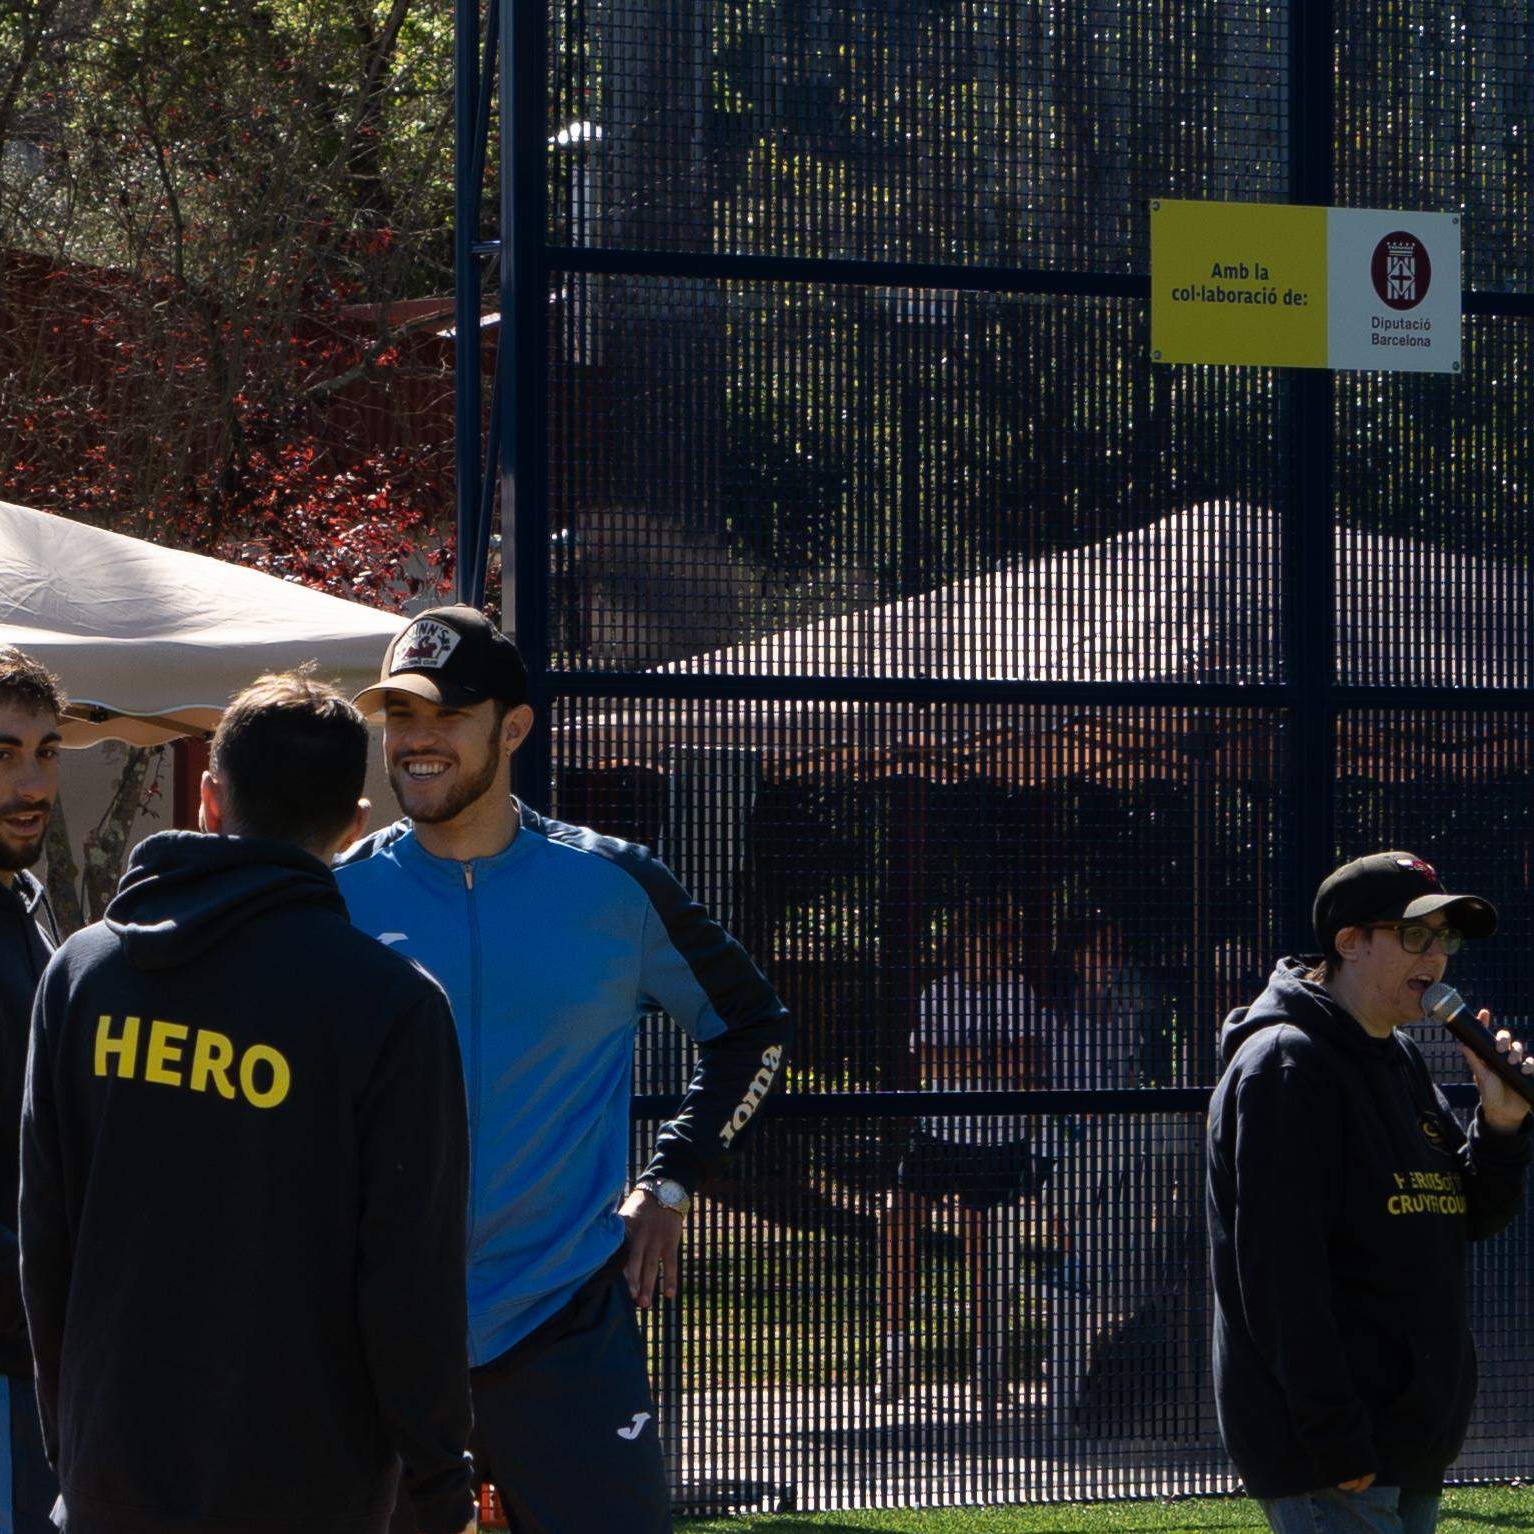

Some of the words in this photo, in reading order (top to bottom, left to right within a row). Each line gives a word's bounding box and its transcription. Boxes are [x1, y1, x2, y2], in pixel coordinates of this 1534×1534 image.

[1210, 262, 1249, 280] Amb
[1254, 262, 1270, 281] la
[1171, 284, 1278, 305] col·laboració
[1282, 288, 1308, 307] de:
[1371, 315, 1432, 332] Diputació
[1371, 332, 1432, 347] Barcelona
[93, 1014, 291, 1109] HERO
